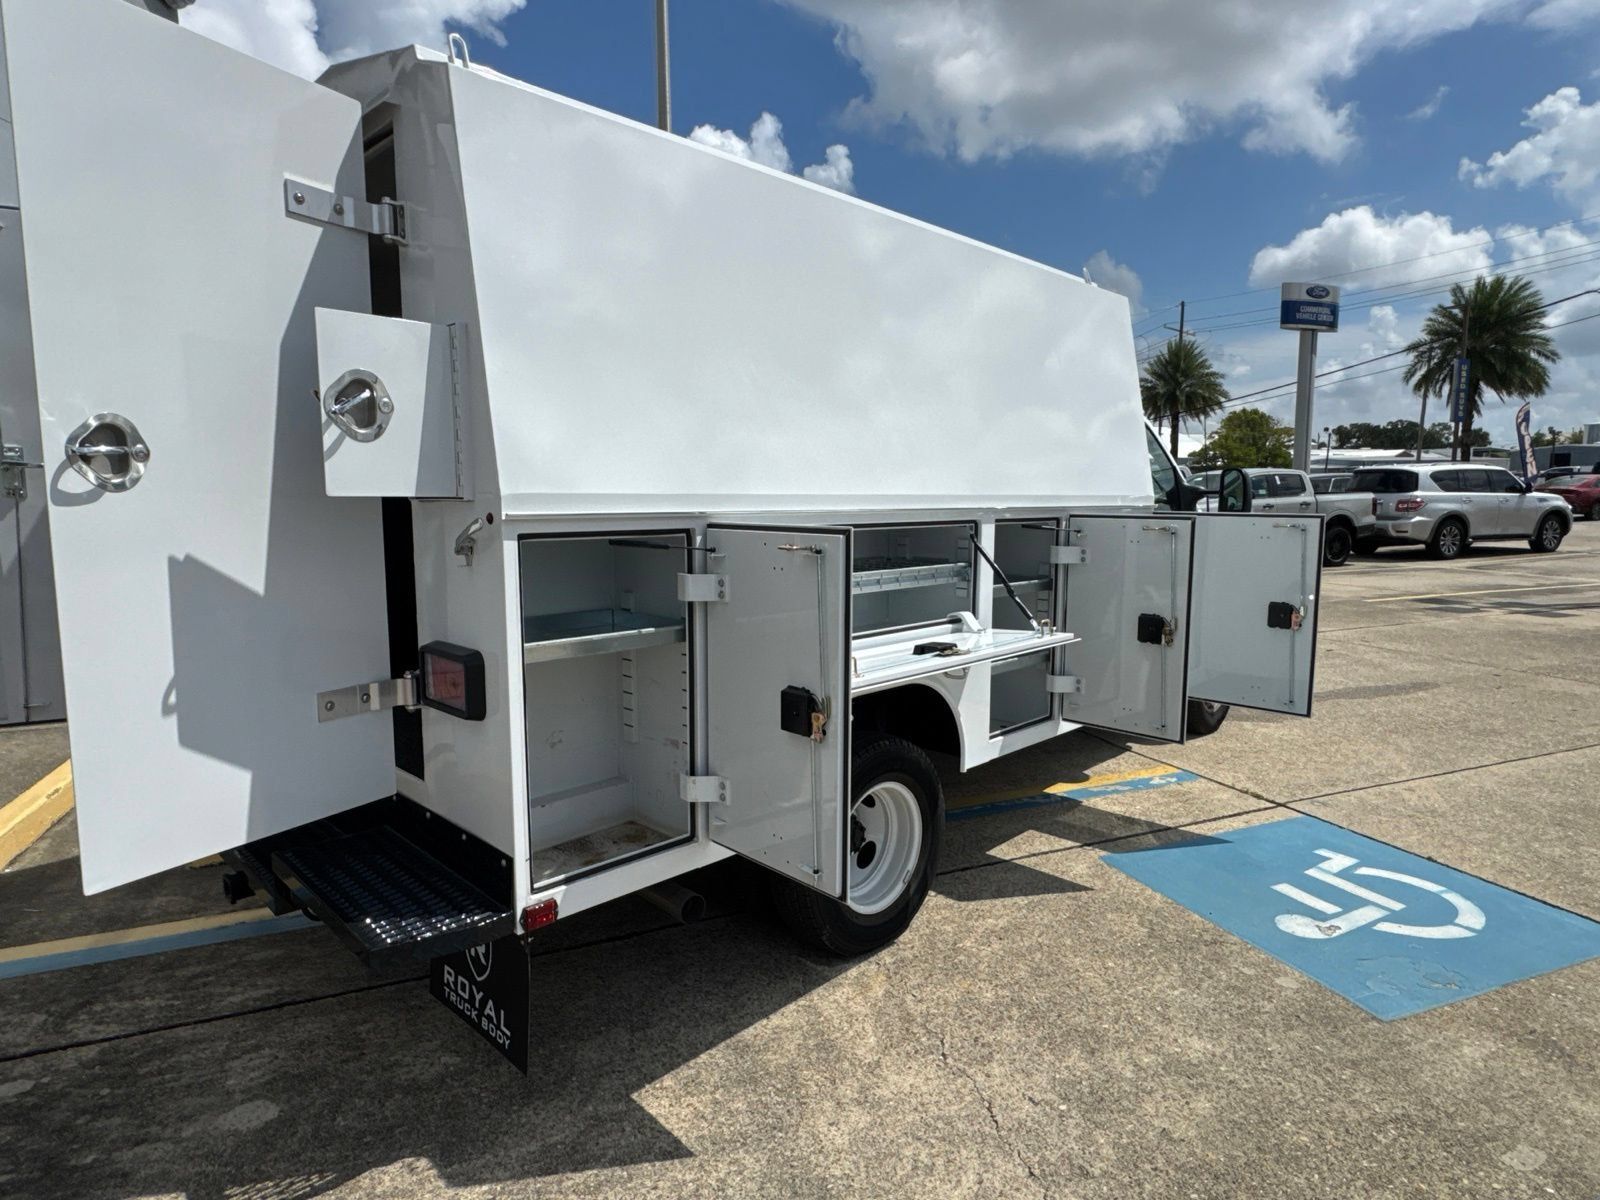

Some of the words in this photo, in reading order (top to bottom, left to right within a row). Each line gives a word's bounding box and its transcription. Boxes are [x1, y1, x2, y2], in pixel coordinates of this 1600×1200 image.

[1460, 365, 1468, 389] USED
[443, 964, 511, 1037] ROYAL
[443, 986, 479, 1023] TRUCK
[481, 1016, 511, 1049] BODY
